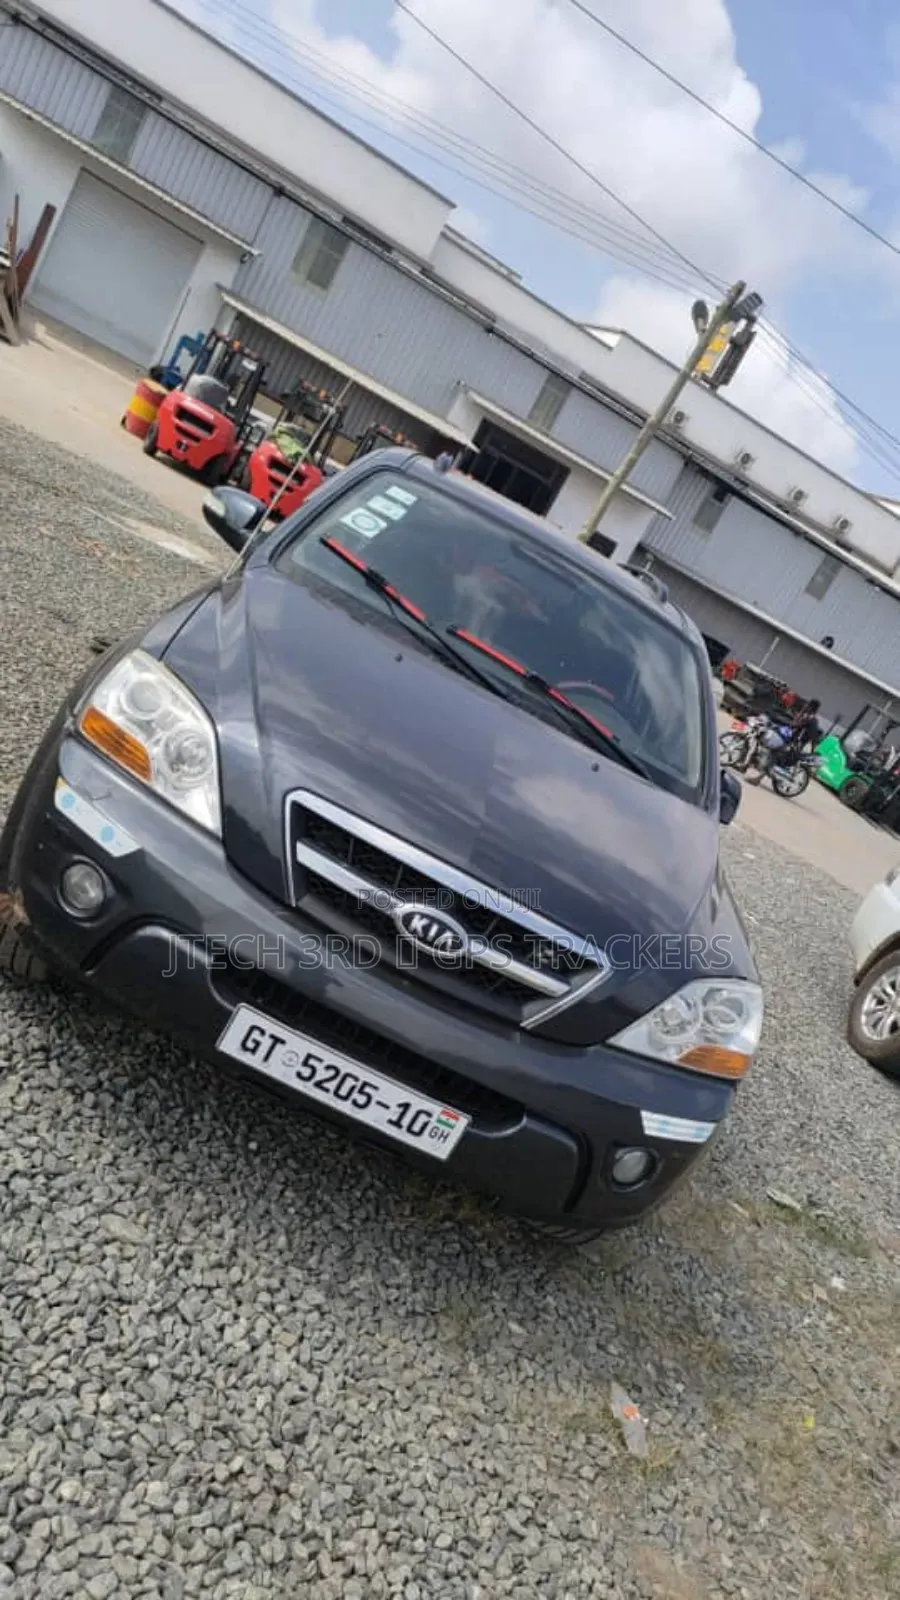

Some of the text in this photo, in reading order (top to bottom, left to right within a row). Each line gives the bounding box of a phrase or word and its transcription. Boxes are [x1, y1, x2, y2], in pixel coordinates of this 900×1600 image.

[408, 913, 454, 954] KIA
[240, 1024, 433, 1138] GT 5205-10
[427, 1126, 451, 1144] GH
